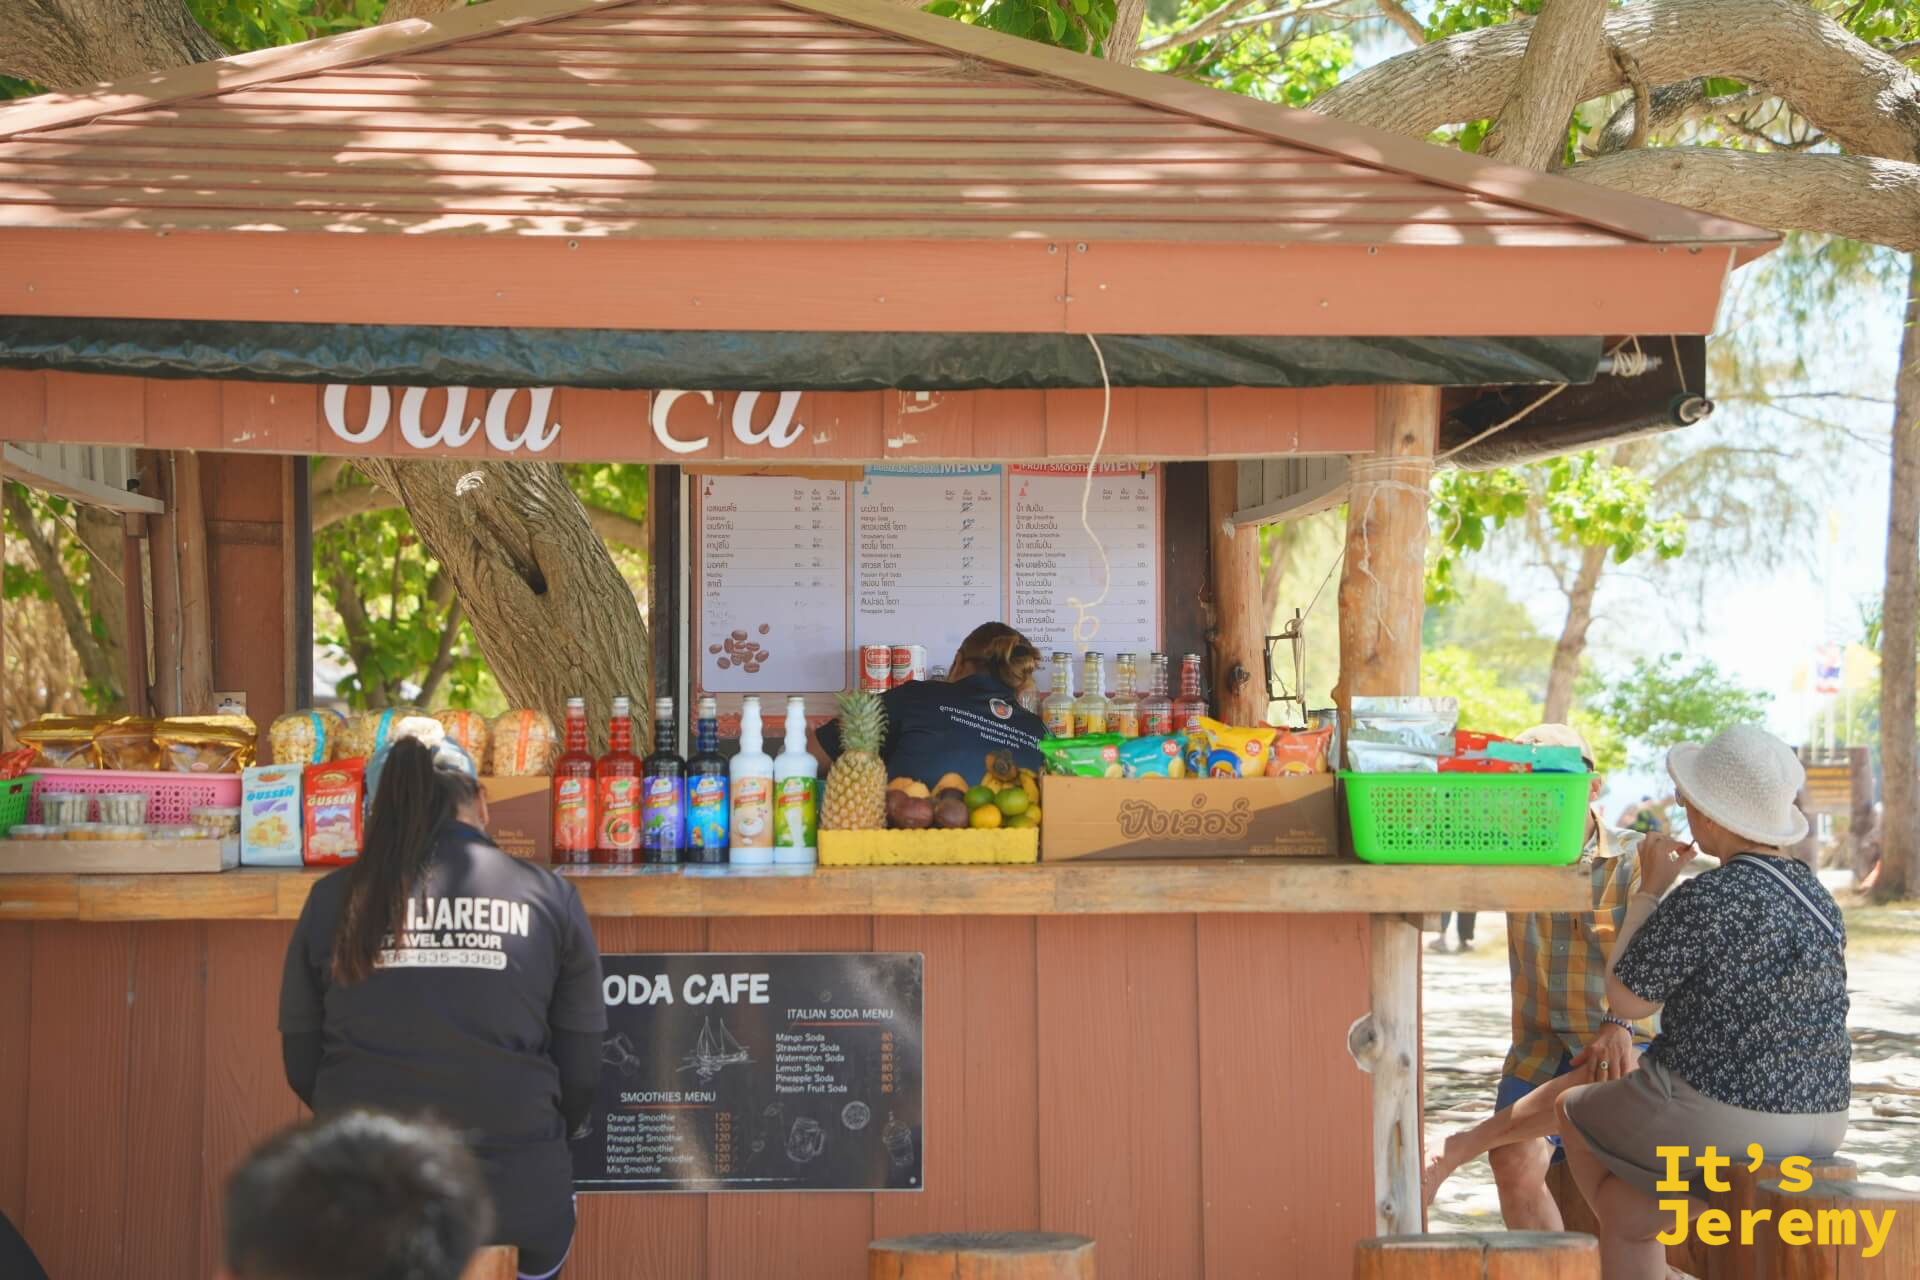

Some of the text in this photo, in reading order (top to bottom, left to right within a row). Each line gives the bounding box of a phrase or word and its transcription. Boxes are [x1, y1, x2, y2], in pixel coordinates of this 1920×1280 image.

[403, 898, 529, 937] IJAREON
[682, 973, 770, 1005] CAFE
[788, 1008, 894, 1019] ITALIAN SODA MENU
[776, 1033, 803, 1042] Mango
[805, 1033, 824, 1042] Soda
[776, 1043, 818, 1053] Strawberry
[820, 1043, 840, 1052] Soda
[776, 1054, 822, 1062] Watermelon
[825, 1054, 844, 1062] Soda
[776, 1064, 802, 1072] Lemon
[804, 1064, 824, 1072] Soda
[776, 1074, 812, 1084] Pineapple
[814, 1074, 834, 1082] Soda
[776, 1084, 804, 1093] Passion
[808, 1084, 825, 1093] Fruit
[828, 1084, 848, 1093] Soda
[620, 1091, 716, 1102] SMOOTHIES MENU
[607, 1113, 636, 1123] Orange
[638, 1113, 676, 1122] Smoothie
[607, 1124, 636, 1132] Banana
[638, 1124, 676, 1132] Smoothie
[607, 1134, 644, 1143] Pineapple
[607, 1144, 634, 1154] Mango
[636, 1144, 674, 1152] Smoothie
[607, 1154, 654, 1164] Watermelon
[607, 1165, 622, 1174] Mix
[624, 1164, 661, 1174] Smoothie
